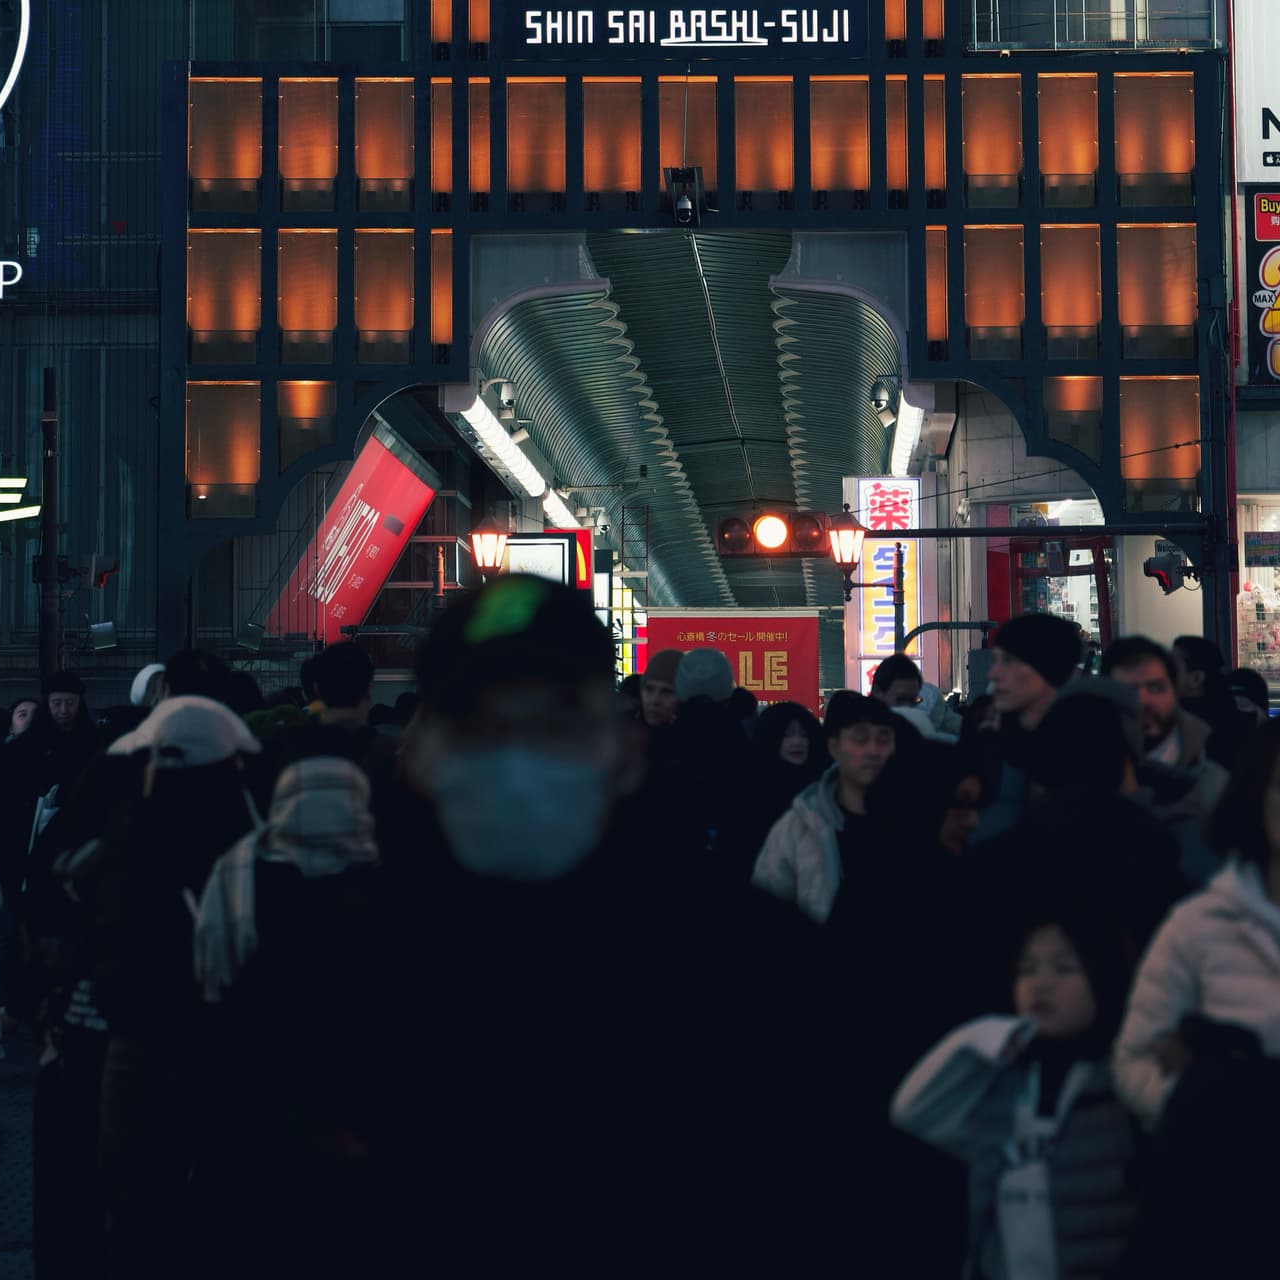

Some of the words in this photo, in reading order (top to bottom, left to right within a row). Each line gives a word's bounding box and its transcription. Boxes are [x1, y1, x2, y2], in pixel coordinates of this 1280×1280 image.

[524, 10, 594, 45] SHIN
[1254, 294, 1274, 304] MAX
[868, 482, 911, 530] 薬
